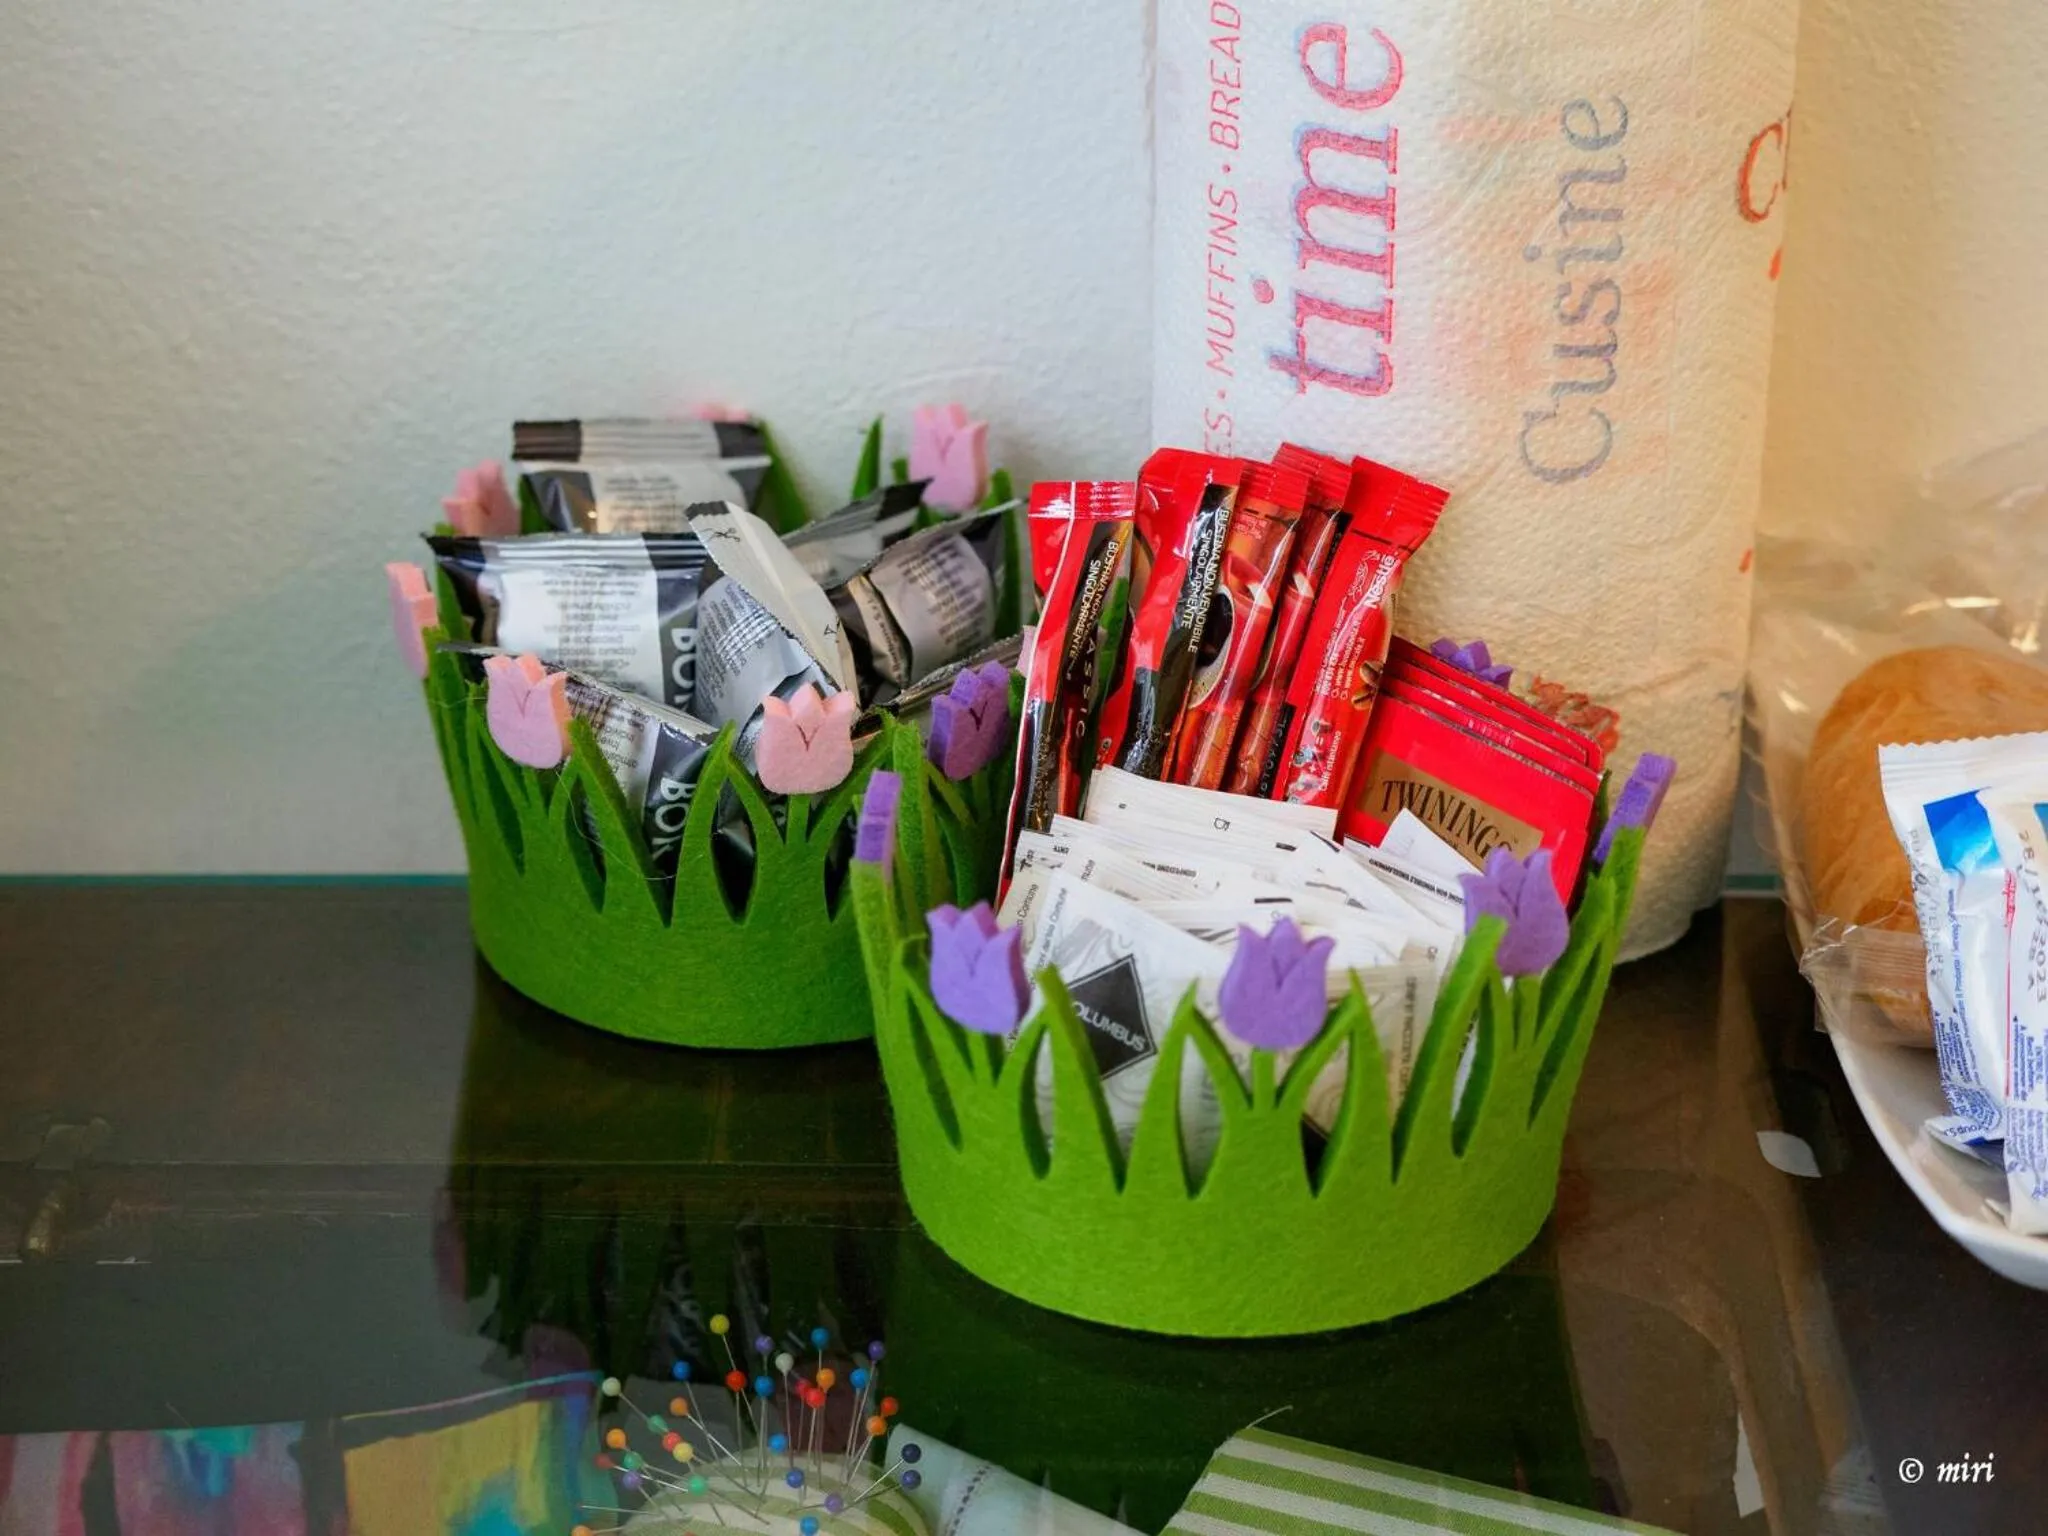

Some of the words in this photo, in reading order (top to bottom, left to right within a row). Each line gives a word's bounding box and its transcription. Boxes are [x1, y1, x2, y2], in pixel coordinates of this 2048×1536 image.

[1209, 0, 1242, 150] BREAD
[1252, 20, 1405, 397] time
[1204, 182, 1239, 378] MUFFINS
[1518, 93, 1629, 485] Cusine
[1181, 529, 1213, 630] SINGOLARMENTE
[1203, 561, 1221, 590] NON
[1211, 508, 1230, 562] BUSTINA
[1187, 588, 1214, 655] VENDIBILE
[1071, 1001, 1146, 1053] OLUMBUS
